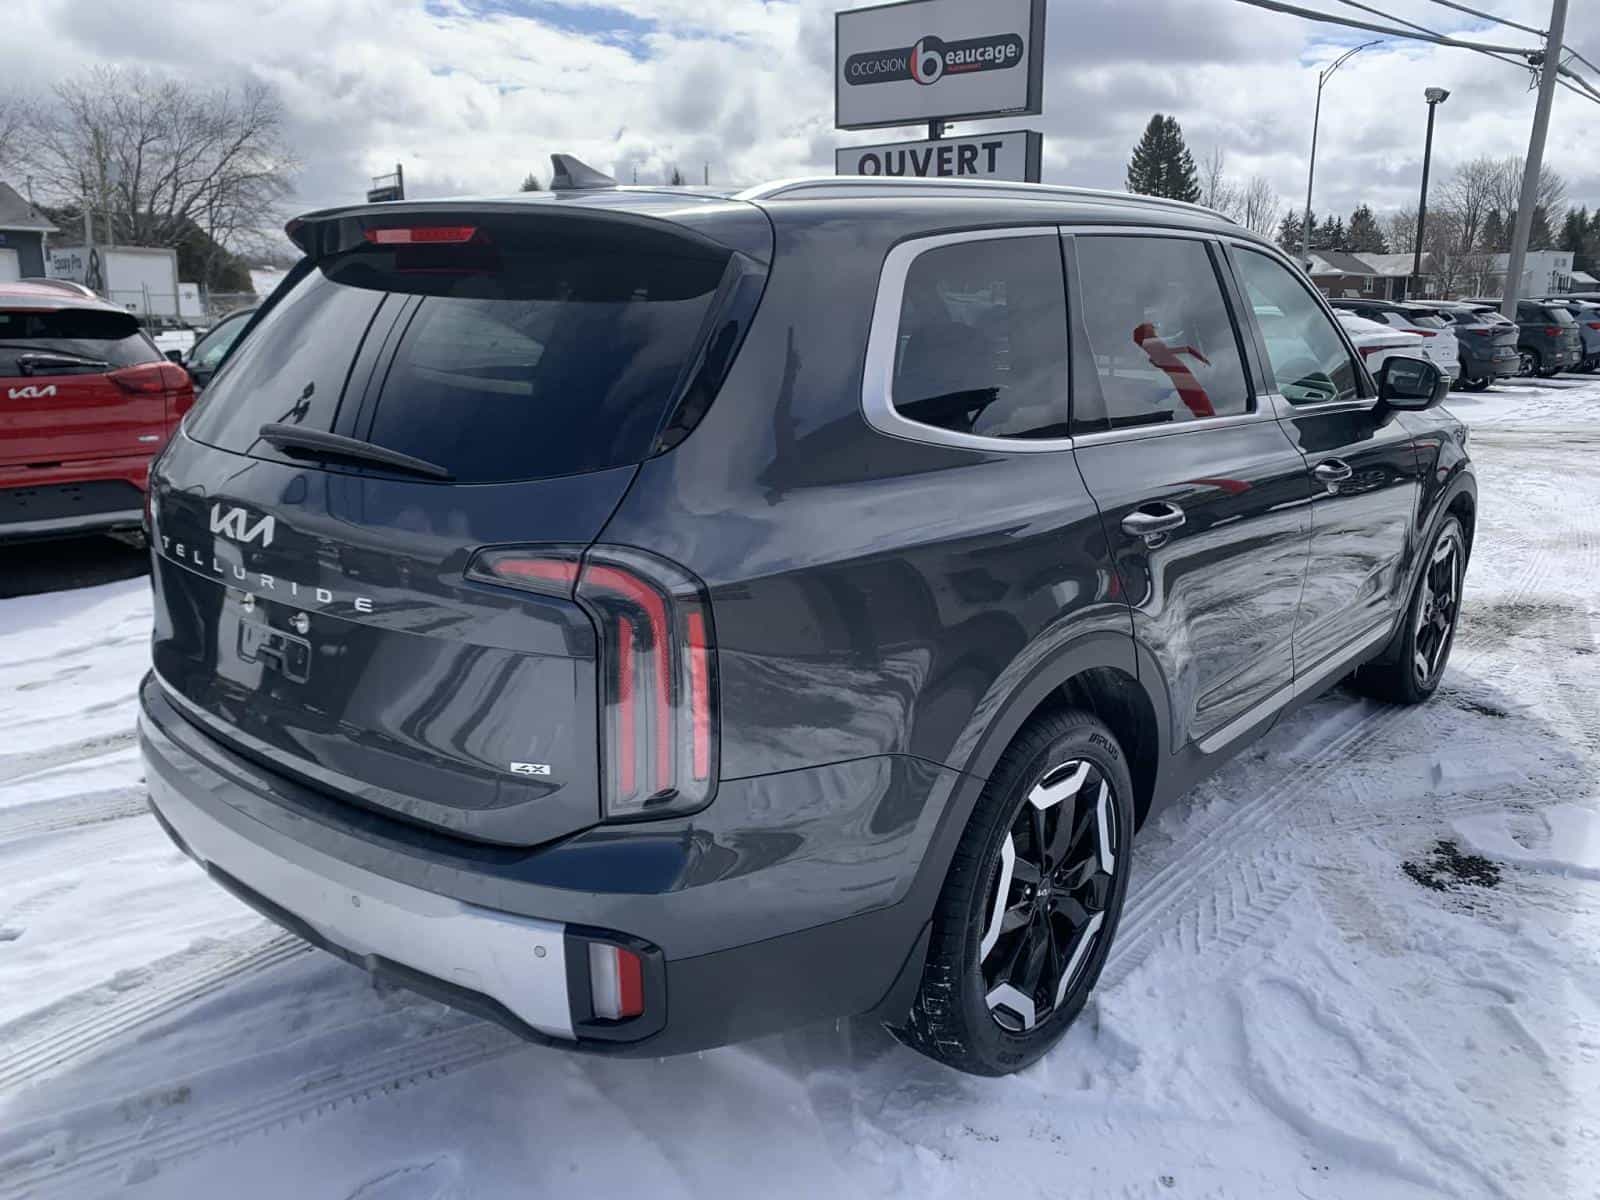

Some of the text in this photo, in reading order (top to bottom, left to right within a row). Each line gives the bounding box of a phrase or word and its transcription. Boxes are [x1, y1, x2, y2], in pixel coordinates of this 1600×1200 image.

[851, 57, 906, 76] OCCASION
[858, 141, 1002, 177] OUVERT
[209, 502, 275, 548] KIA
[161, 535, 374, 613] TELLURIDE
